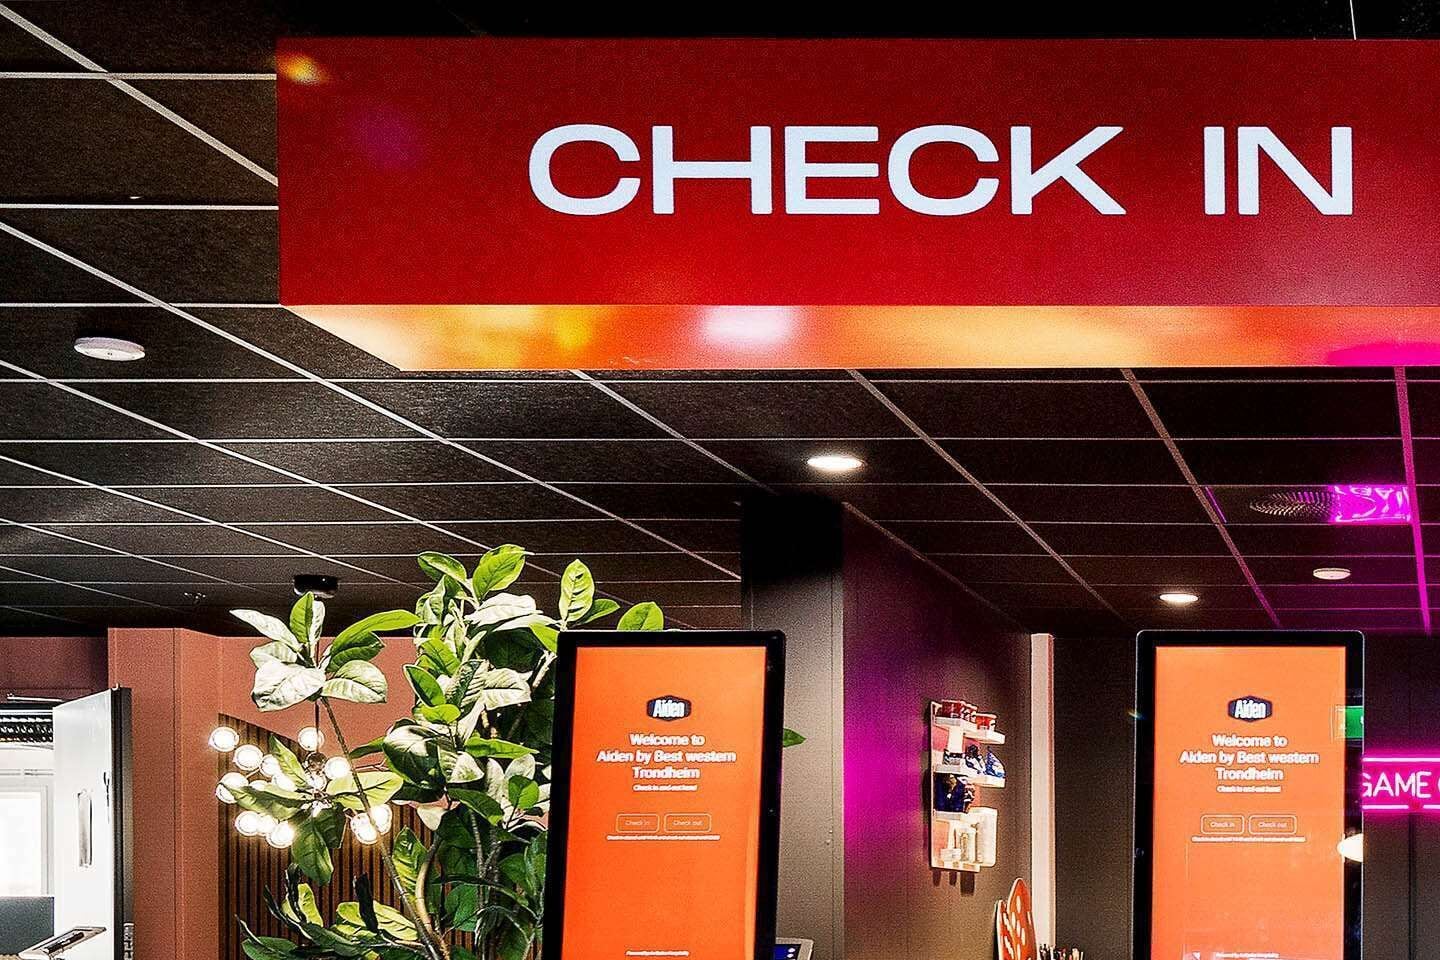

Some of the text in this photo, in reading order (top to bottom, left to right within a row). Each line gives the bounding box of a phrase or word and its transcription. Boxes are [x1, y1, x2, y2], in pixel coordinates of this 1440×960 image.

[528, 123, 1353, 216] CHECK IN
[652, 699, 685, 718] Aiden
[1234, 699, 1267, 719] Aiden
[629, 733, 706, 746] Welcome to
[1211, 734, 1288, 747] Welcome to
[596, 749, 737, 765] Aiden by Best western
[1179, 750, 1320, 766] Aiden by Best western
[631, 766, 701, 779] Trondheim
[1214, 767, 1284, 780] Trondheim
